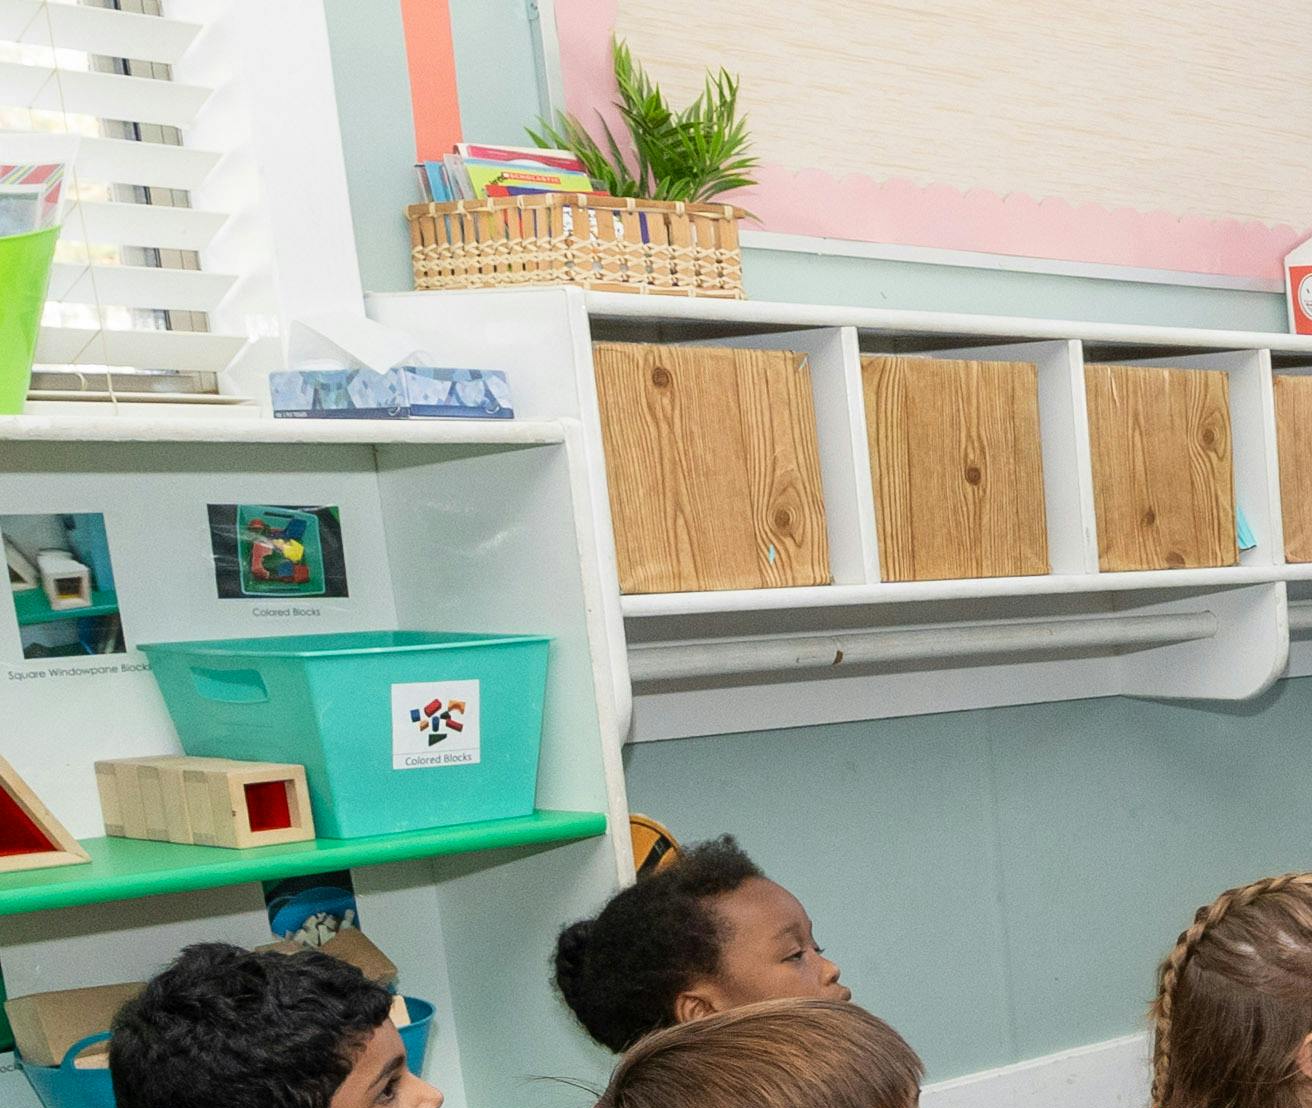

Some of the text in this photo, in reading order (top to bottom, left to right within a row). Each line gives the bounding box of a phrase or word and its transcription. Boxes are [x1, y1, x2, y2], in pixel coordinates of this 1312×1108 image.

[252, 607, 321, 617] Colored Blocks
[8, 670, 46, 681] Square
[49, 664, 118, 677] Windowpane
[405, 753, 472, 766] Colored Blocks
